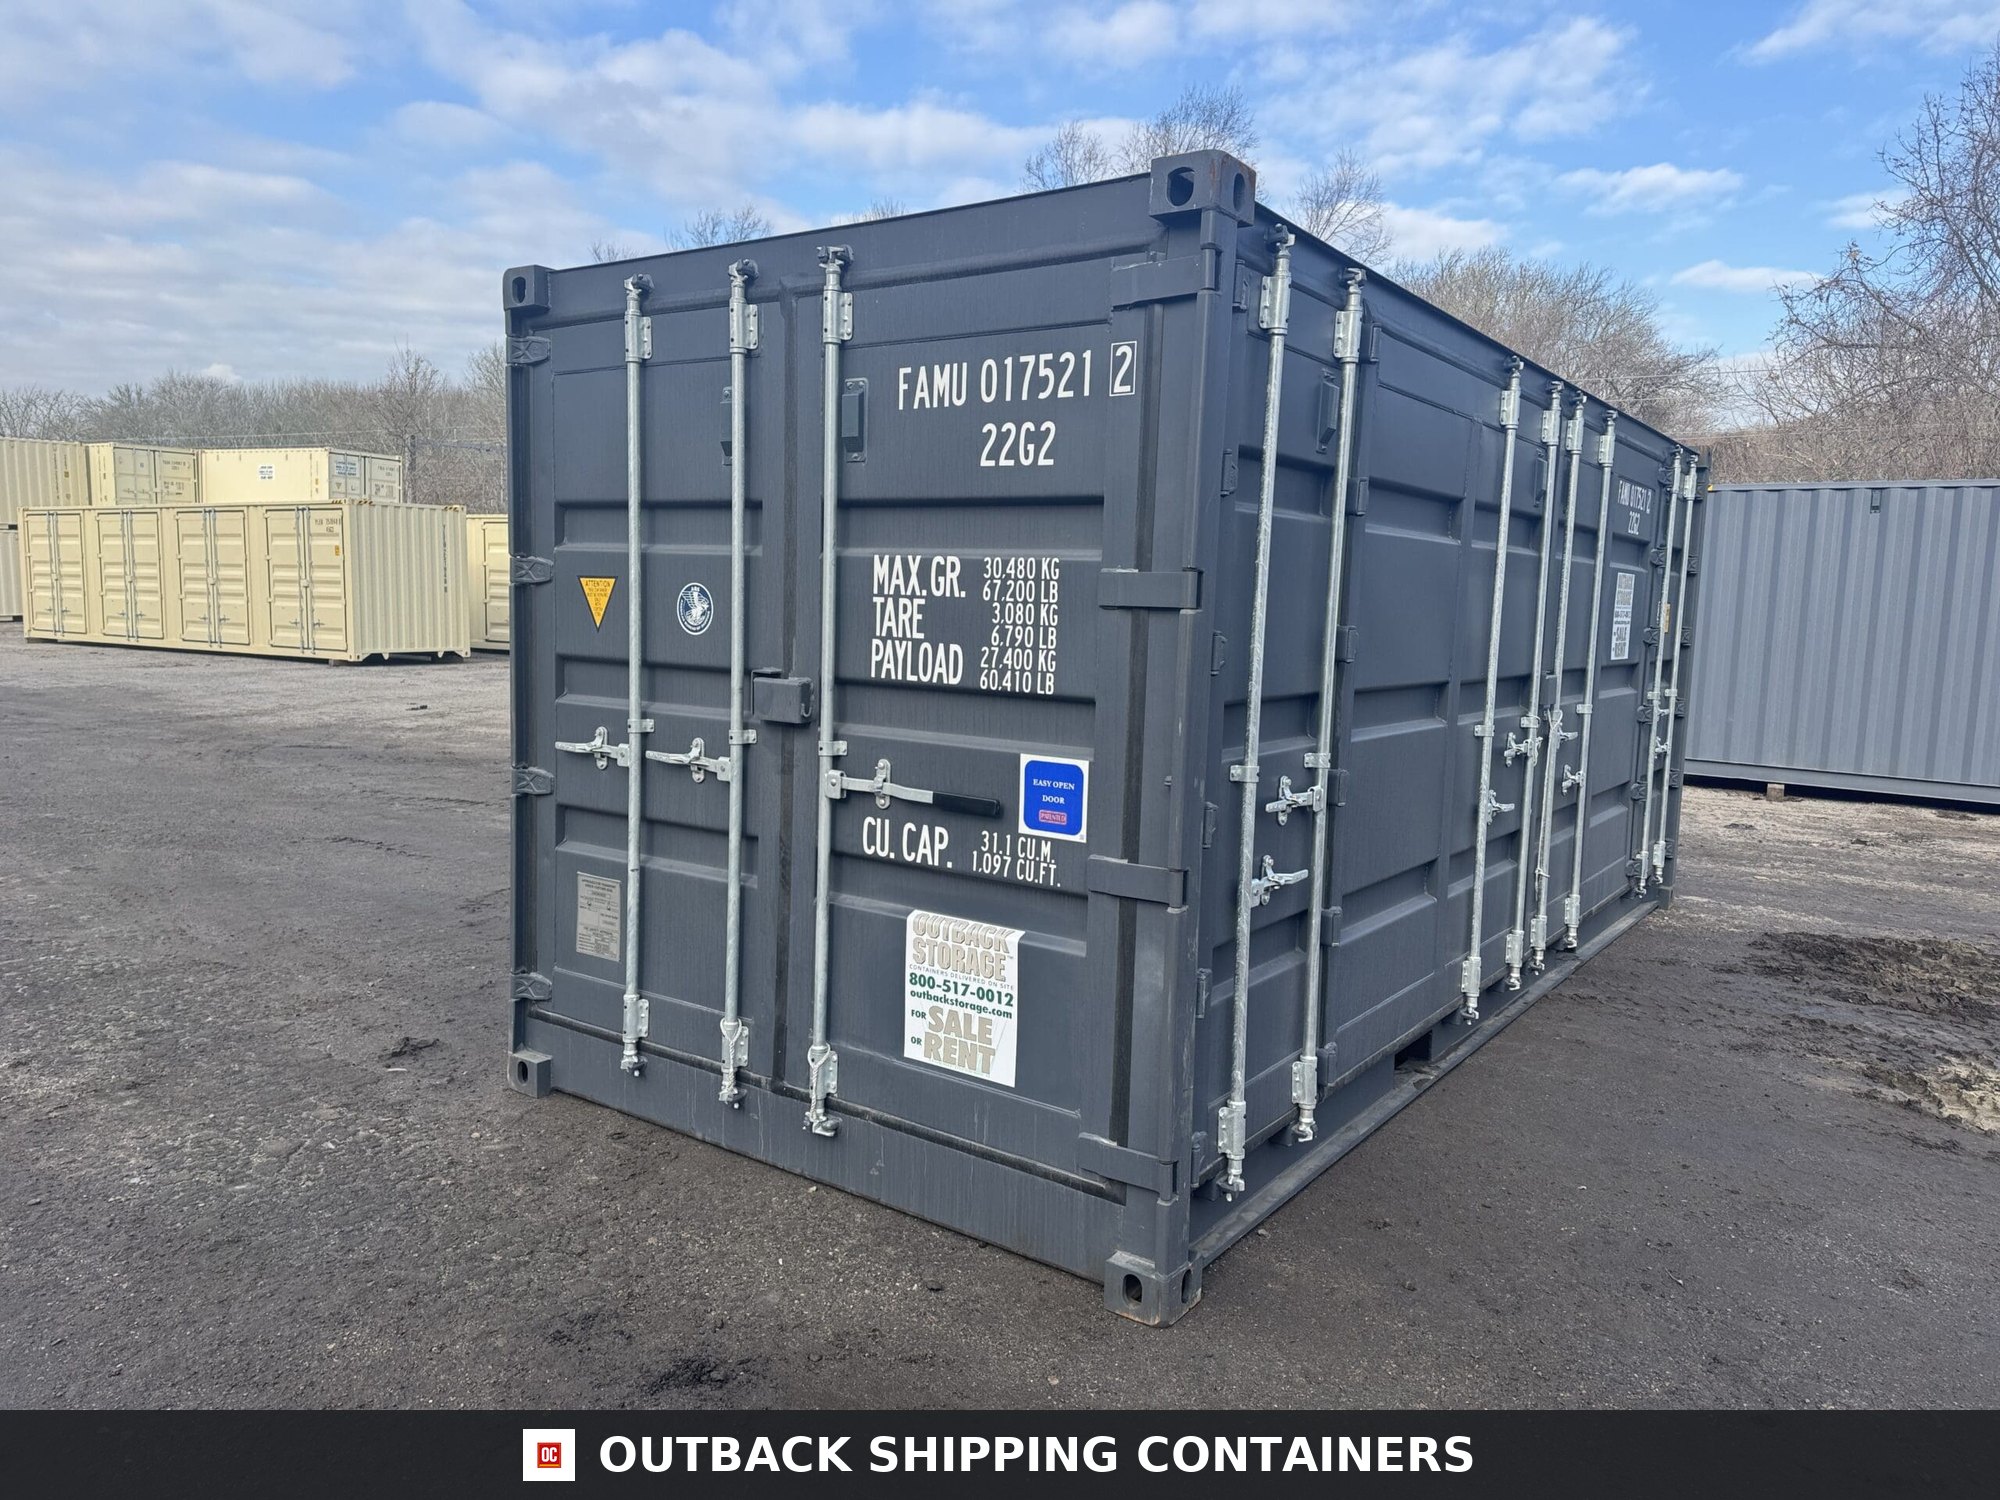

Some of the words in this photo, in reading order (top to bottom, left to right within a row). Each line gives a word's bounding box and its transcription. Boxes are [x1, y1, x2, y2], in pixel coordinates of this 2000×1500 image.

[898, 362, 967, 410] FAMU
[980, 350, 1092, 403] 017521
[1113, 345, 1133, 393] 2
[980, 421, 1056, 467] 22G2
[983, 557, 1036, 579] 30,480
[1041, 557, 1060, 580] KG
[982, 579, 1035, 602] 67,200
[1040, 581, 1058, 603] LB
[873, 597, 926, 639] TARE
[992, 602, 1035, 625] 3,080
[1040, 604, 1059, 626] KG
[991, 625, 1034, 648] 6,790
[1039, 627, 1057, 650] LB
[870, 638, 964, 685] PAYLOAD
[980, 647, 1033, 670] 27,400
[1038, 650, 1057, 672] KG
[979, 669, 1032, 693] 60,410
[1037, 673, 1055, 695] LB
[1033, 778, 1053, 788] EASY
[1052, 781, 1075, 790] OPEN
[1042, 795, 1065, 805] DOOR
[862, 816, 895, 859] CU.
[902, 822, 953, 869] CAP.
[981, 830, 1011, 855] 31.1
[972, 850, 1010, 878] 1,097
[912, 912, 1016, 954] OUTBACK
[909, 964, 948, 977] CONTAINERS
[950, 972, 986, 985] DELIVERED
[912, 937, 1007, 983] STORAGE
[909, 972, 1014, 1007] 800-517-0012
[910, 989, 1013, 1019] outbackstorage.com
[911, 1009, 926, 1020] FOR
[928, 1005, 992, 1046] SALE
[910, 1036, 922, 1045] OR
[923, 1031, 996, 1075] RENT
